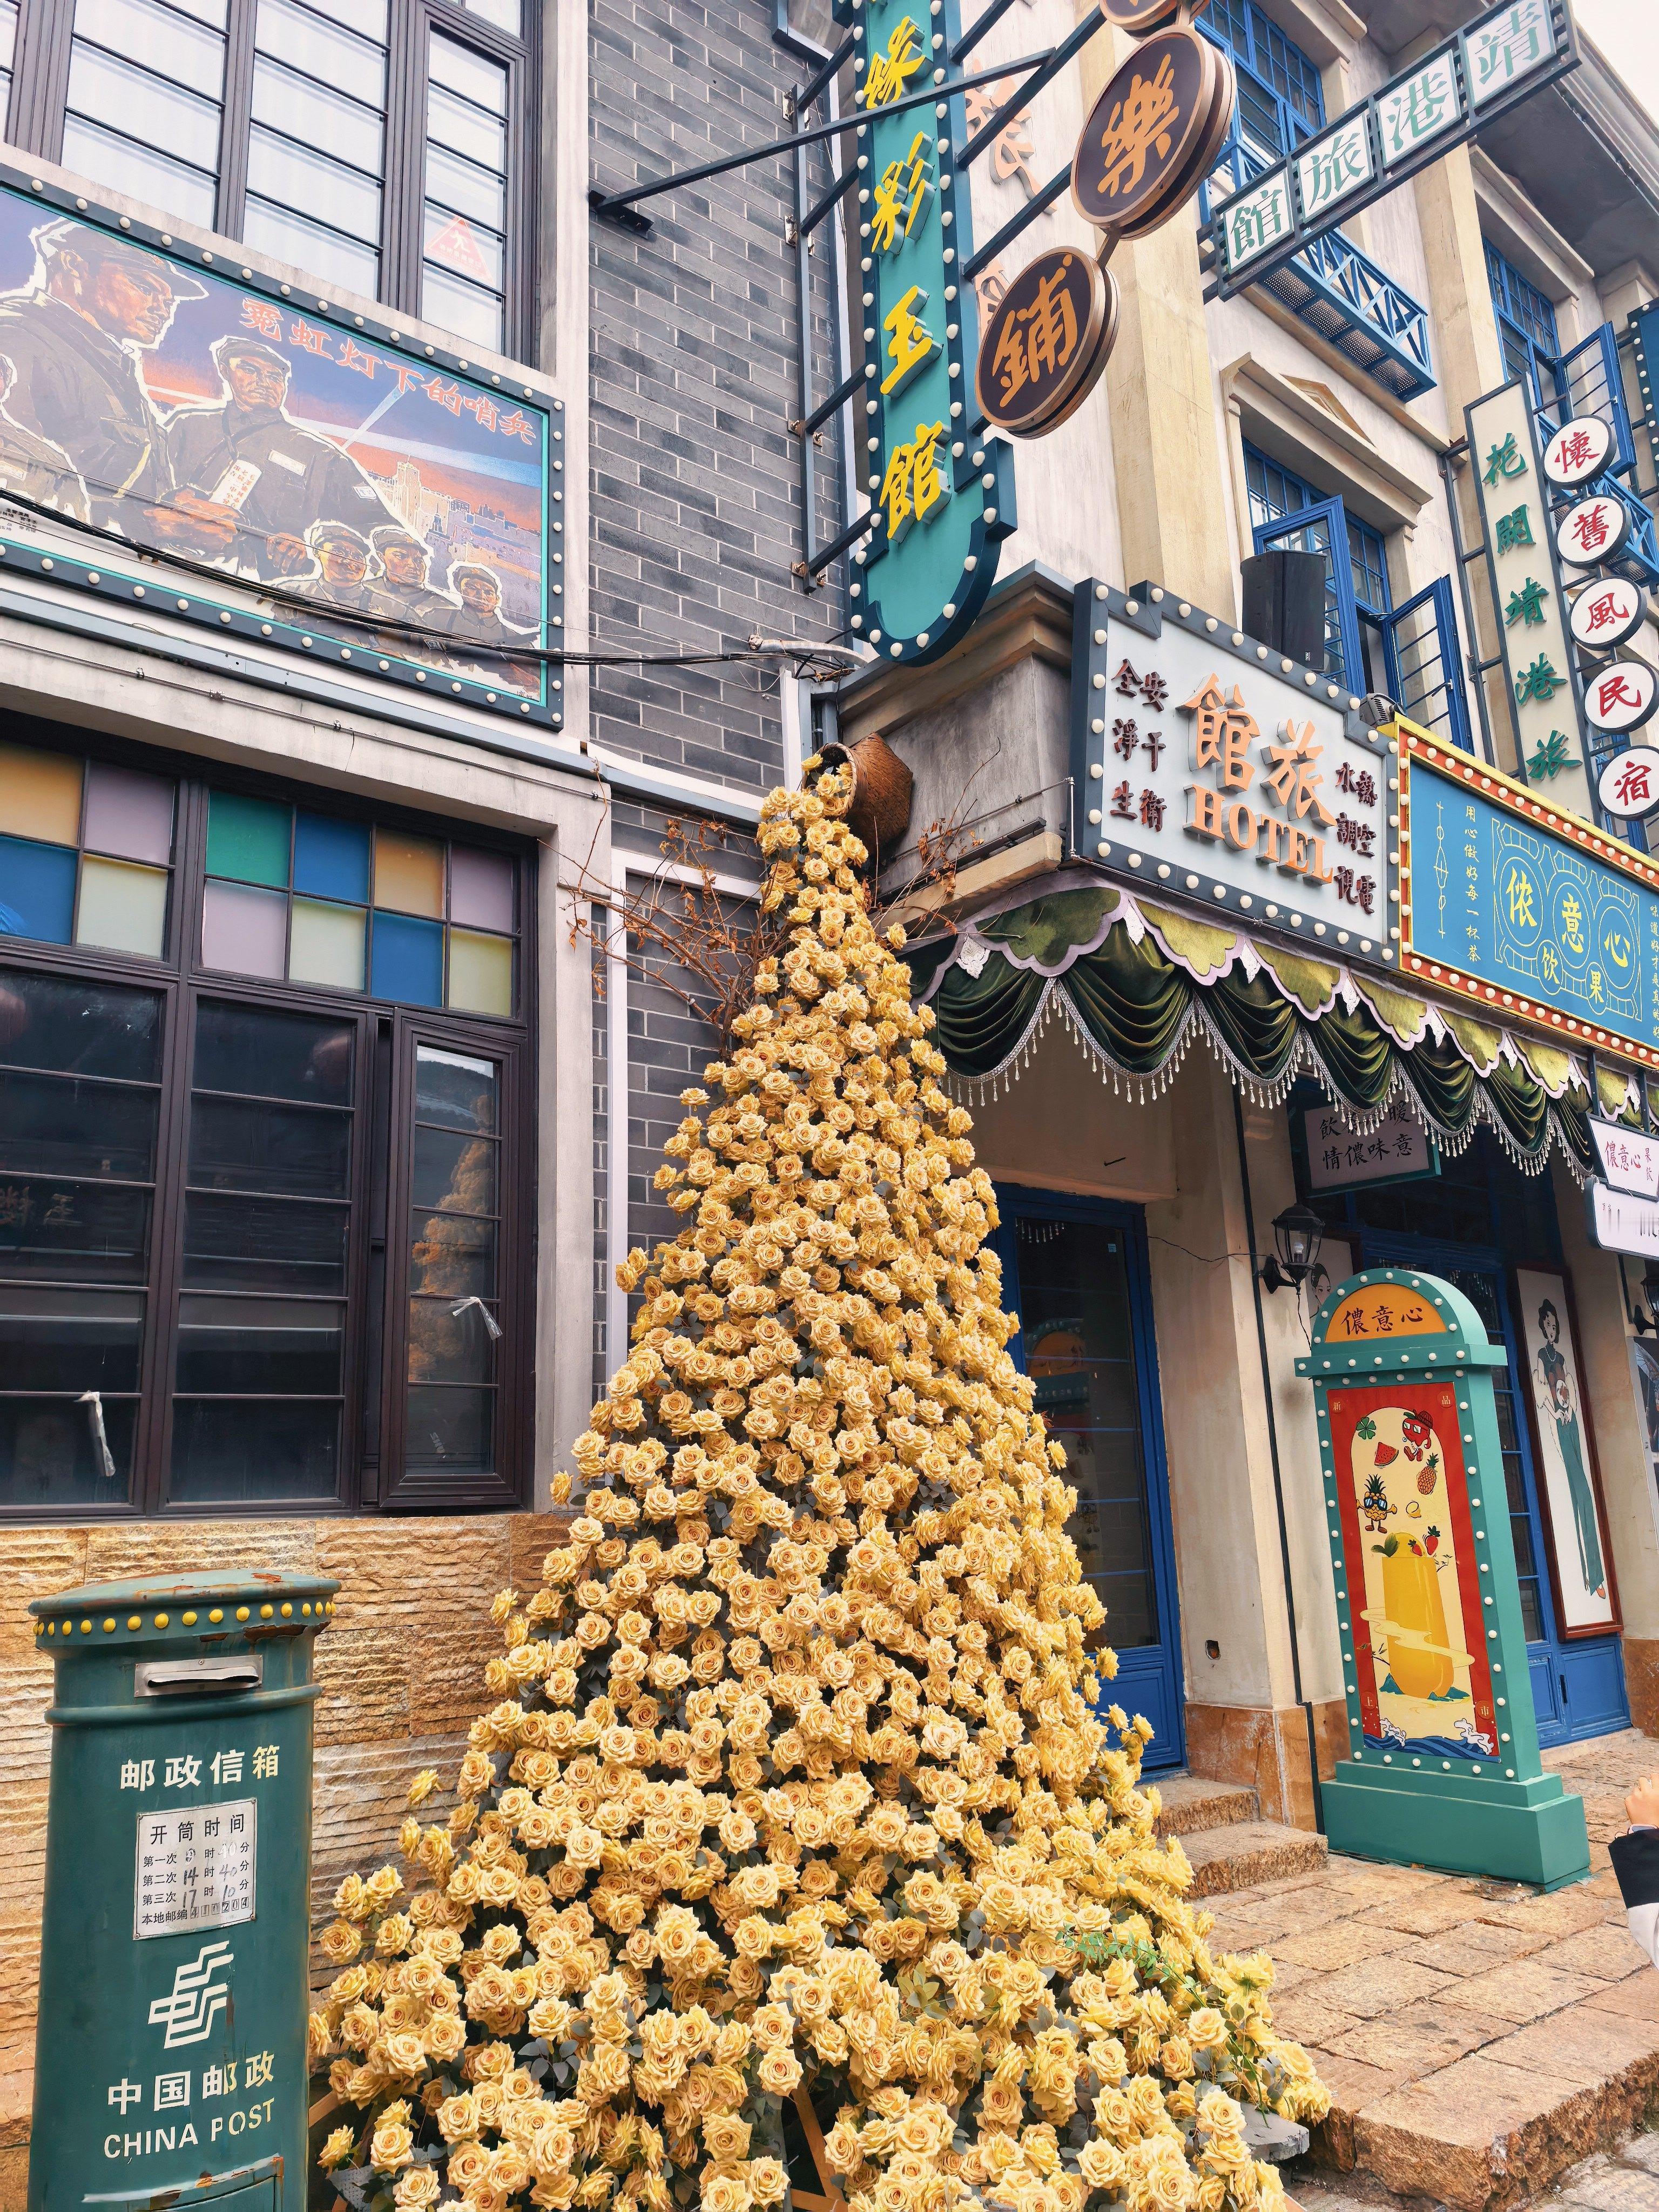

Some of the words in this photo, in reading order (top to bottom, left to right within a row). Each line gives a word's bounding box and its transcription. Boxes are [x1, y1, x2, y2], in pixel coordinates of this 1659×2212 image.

[992, 0, 1179, 408] 樂鋪
[239, 298, 537, 446] 霓虹灯下的哨兵
[1482, 432, 1588, 821] 花開靖港旅
[1554, 430, 1652, 806] 懷舊風民宿
[1183, 784, 1333, 885] HOTEL
[1464, 805, 1481, 962] 用心做好每一杯茶
[1333, 1401, 1341, 1411] 新
[1441, 1395, 1451, 1405] 品
[1365, 1696, 1374, 1707] 上
[1480, 1705, 1489, 1716] 市
[120, 1744, 280, 1792] 邮政信箱
[143, 1853, 177, 1868] 第一次
[205, 1847, 215, 1859] 时
[240, 1841, 249, 1853] 分
[151, 1813, 244, 1845] 开筒时间
[142, 1891, 177, 1906] 第三次
[183, 1889, 197, 1908] 17
[204, 1885, 214, 1897] 时
[239, 1879, 249, 1891] 分
[143, 1872, 177, 1887] 第二次
[184, 1866, 199, 1886] 14
[204, 1866, 215, 1878] 时
[240, 1859, 249, 1872] 分
[141, 1908, 187, 1925] 本地邮编
[107, 2051, 274, 2115] 中国邮政
[104, 2123, 199, 2158] CHINA
[211, 2098, 275, 2142] POST
